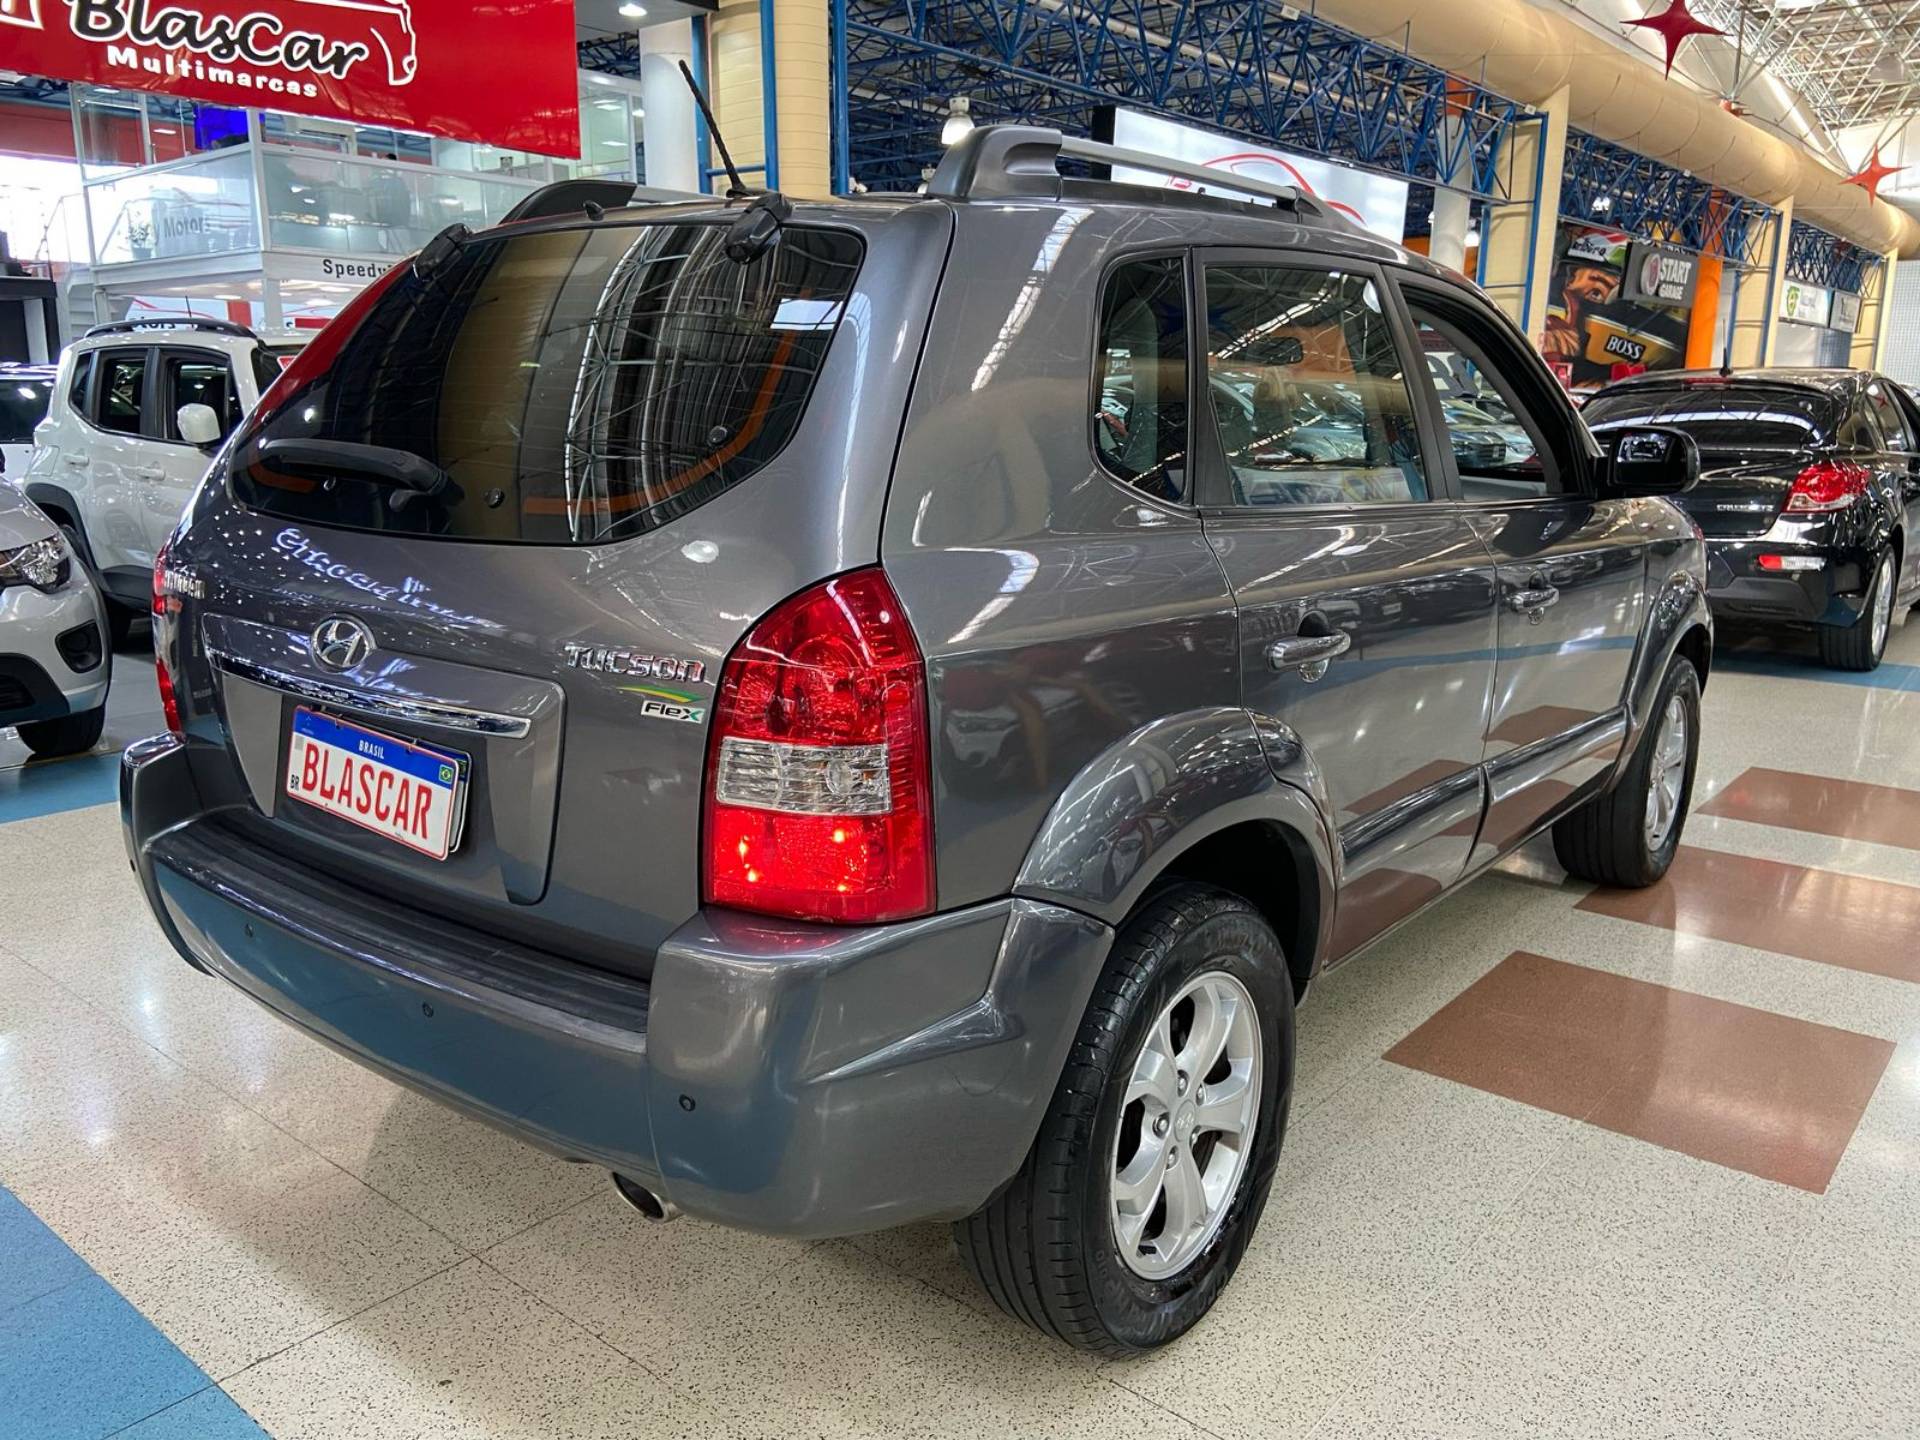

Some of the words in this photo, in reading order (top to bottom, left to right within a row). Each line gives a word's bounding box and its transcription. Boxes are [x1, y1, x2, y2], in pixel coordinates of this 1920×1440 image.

[64, 0, 369, 80] BlasCar
[106, 45, 319, 98] Multimarcas
[1660, 258, 1692, 284] START
[1606, 335, 1644, 359] BOSS
[564, 645, 706, 683] TUCSON
[358, 739, 385, 760] BRASIL
[290, 773, 300, 792] BR
[302, 742, 433, 840] BLASCAR
